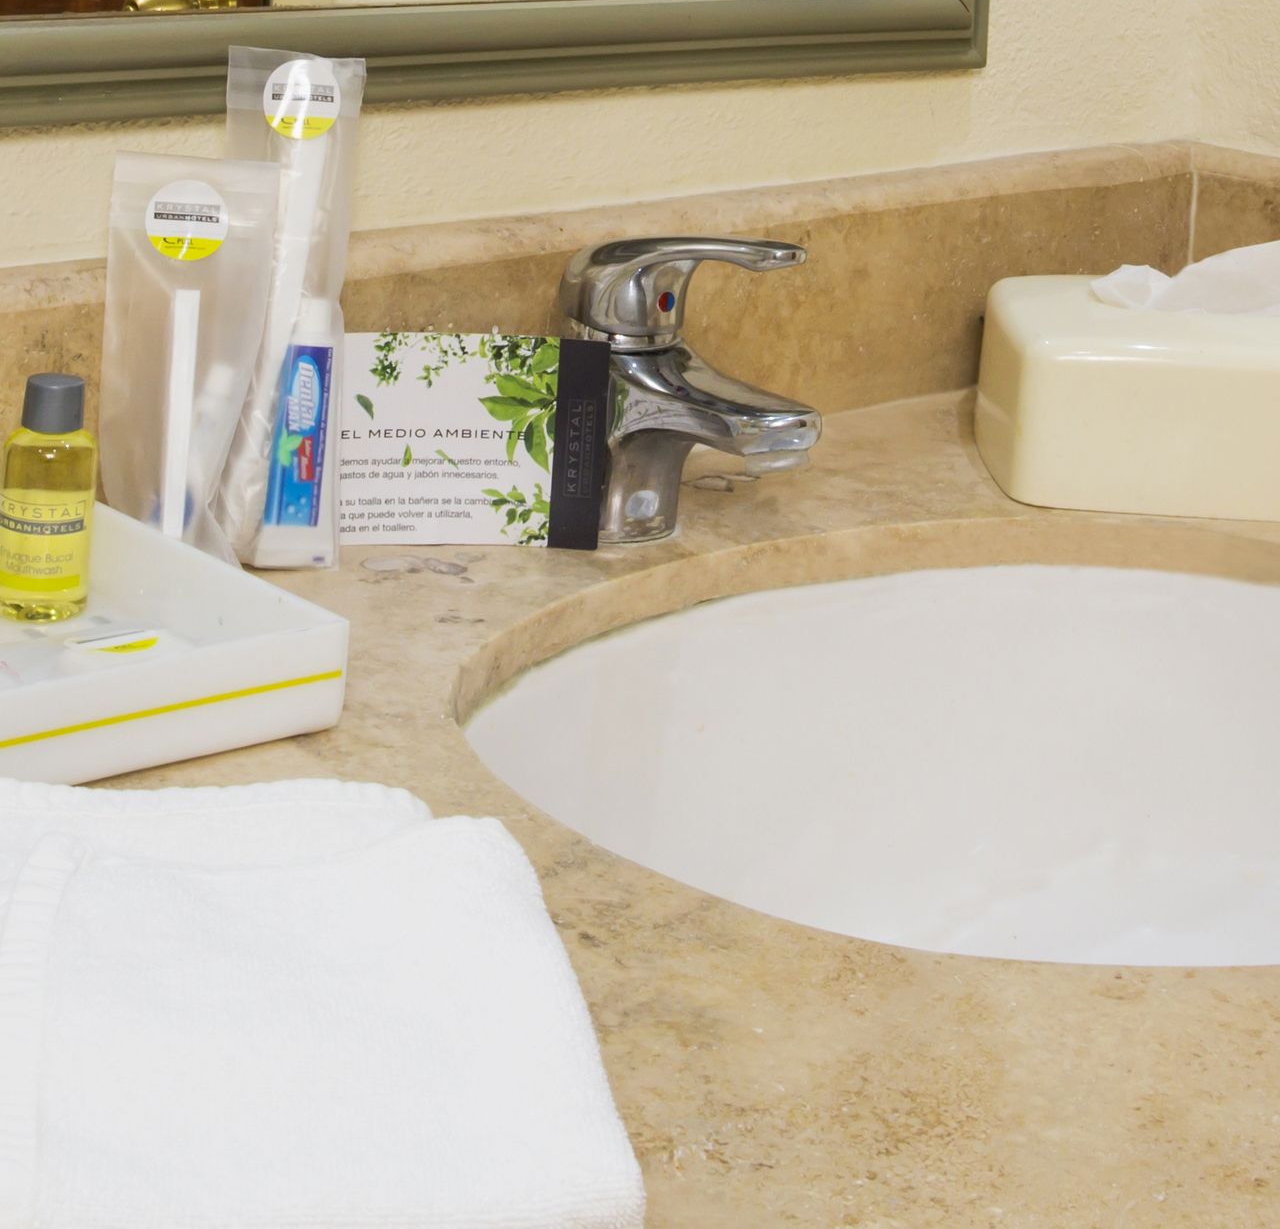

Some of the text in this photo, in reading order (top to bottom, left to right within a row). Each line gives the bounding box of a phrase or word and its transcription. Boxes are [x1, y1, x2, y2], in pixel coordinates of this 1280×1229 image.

[156, 202, 218, 214] KRYSTAL
[340, 428, 526, 441] EL MEDIO AMBIENTE
[567, 404, 582, 493] KRYSTAL
[371, 457, 401, 468] ayudar
[412, 457, 445, 468] mejorar
[448, 457, 481, 466] nuestro
[369, 470, 380, 479] de
[382, 471, 404, 481] agua
[407, 471, 412, 481] y
[414, 470, 439, 480] jabón
[345, 498, 356, 506] su
[358, 496, 382, 506] toalla
[384, 498, 395, 506] en
[398, 496, 406, 505] la
[408, 496, 439, 506] bañera
[441, 498, 452, 506] se
[454, 496, 462, 505] la
[348, 512, 365, 522] que
[367, 510, 395, 521] puede
[397, 509, 424, 519] volver
[426, 511, 432, 519] a
[358, 524, 369, 532] en
[372, 523, 380, 532] el
